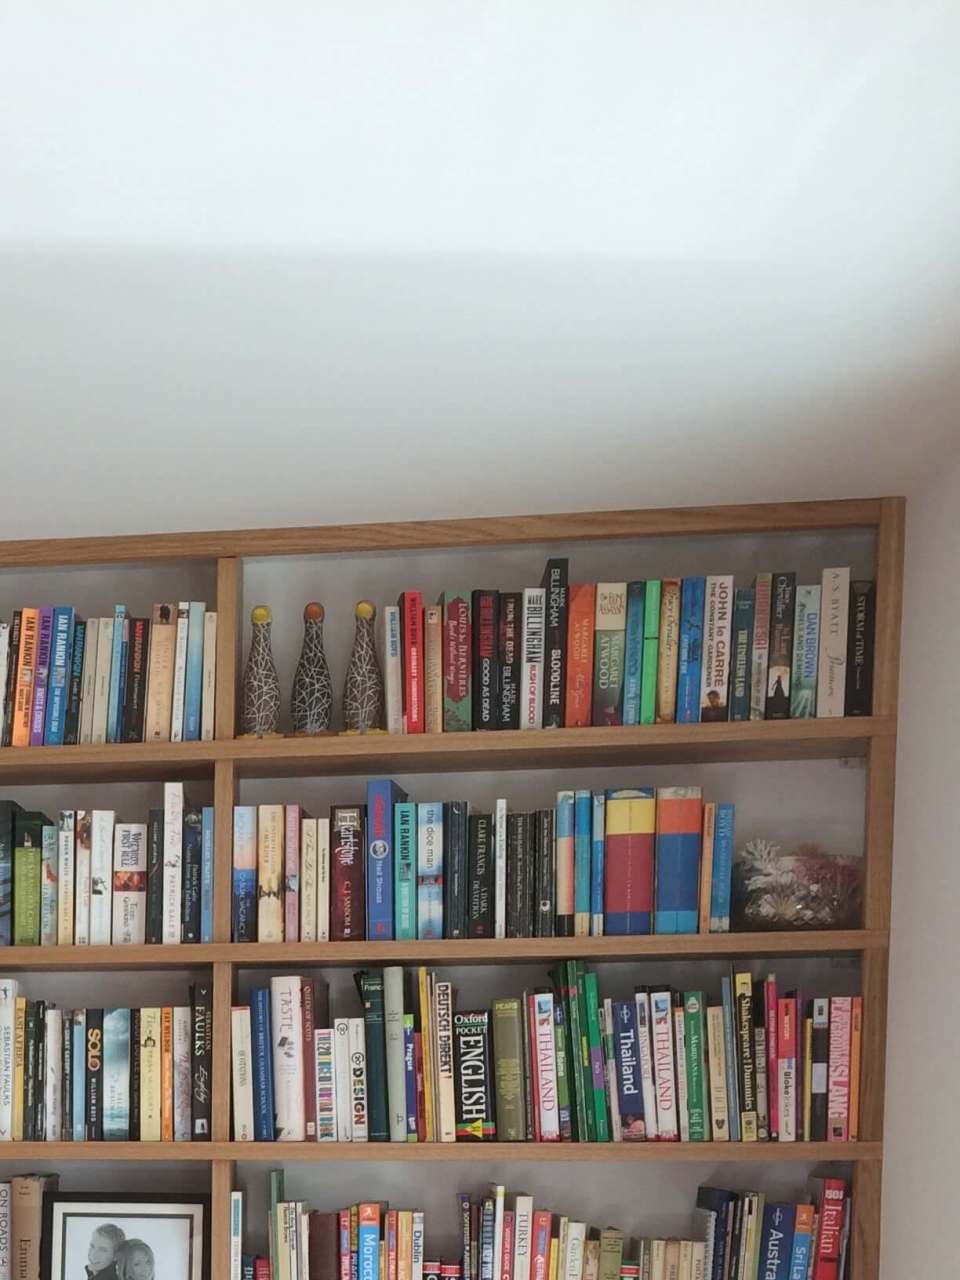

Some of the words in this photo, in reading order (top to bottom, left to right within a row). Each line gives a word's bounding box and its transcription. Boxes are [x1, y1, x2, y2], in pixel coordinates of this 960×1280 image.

[550, 568, 560, 627] BILLINGHAM
[709, 582, 717, 599] THE
[718, 582, 729, 621] JOHN
[775, 577, 786, 619] Chevalier
[24, 617, 34, 632] IAN
[42, 616, 51, 633] IAN
[58, 615, 68, 631] IAN
[459, 603, 468, 633] LOUIS
[526, 606, 542, 664] BILLINGHAM
[707, 601, 716, 642] CONSTANT
[806, 613, 818, 635] DAN
[22, 634, 33, 667] RANKIN
[40, 634, 50, 666] RANKIN
[55, 633, 66, 666] RANKIN
[581, 618, 590, 663] MARGARET
[804, 638, 816, 679] BROWN
[482, 658, 490, 685] GOOD
[550, 649, 561, 705] BLOODLINE
[599, 635, 610, 689] ATWOOD
[610, 636, 620, 689] MARGARET
[705, 645, 713, 688] GARDENER
[482, 686, 489, 698] AS
[482, 699, 490, 722] DEAD
[502, 666, 511, 721] BILLINGHAM
[399, 810, 409, 827] IAN
[426, 809, 434, 825] the
[426, 826, 434, 844] dice
[476, 819, 488, 844] CLARE
[335, 812, 360, 866] Heartstone
[399, 828, 409, 861] RANKIN
[476, 844, 487, 875] FRANCIS
[472, 880, 481, 920] DEVOTION
[195, 1005, 205, 1056] FAULKS
[279, 990, 293, 1033] TASTE
[454, 1014, 488, 1024] Oxford
[740, 997, 752, 1058] Shakespeare
[3, 1026, 11, 1072] SEBASTIAN
[556, 1051, 565, 1076] Rome
[620, 1029, 638, 1095] Thailand
[3, 1073, 11, 1106] FAULKS
[194, 1064, 208, 1103] Engleby
[459, 1034, 486, 1120] ENGLISH
[539, 1029, 555, 1112] THAILAND
[655, 1031, 673, 1111] THAILAND
[742, 1064, 753, 1111] Dummies
[784, 1071, 792, 1095] Bloke
[828, 1062, 849, 1119] SLANG
[352, 1067, 366, 1126] DESIGN
[0, 1189, 8, 1209] ON
[0, 1212, 8, 1252] ROADS
[413, 1230, 422, 1263] Dublin
[517, 1213, 528, 1257] TURKEY
[820, 1204, 842, 1254] Italian
[19, 1239, 32, 1279] Emma
[795, 1247, 806, 1265] Sri
